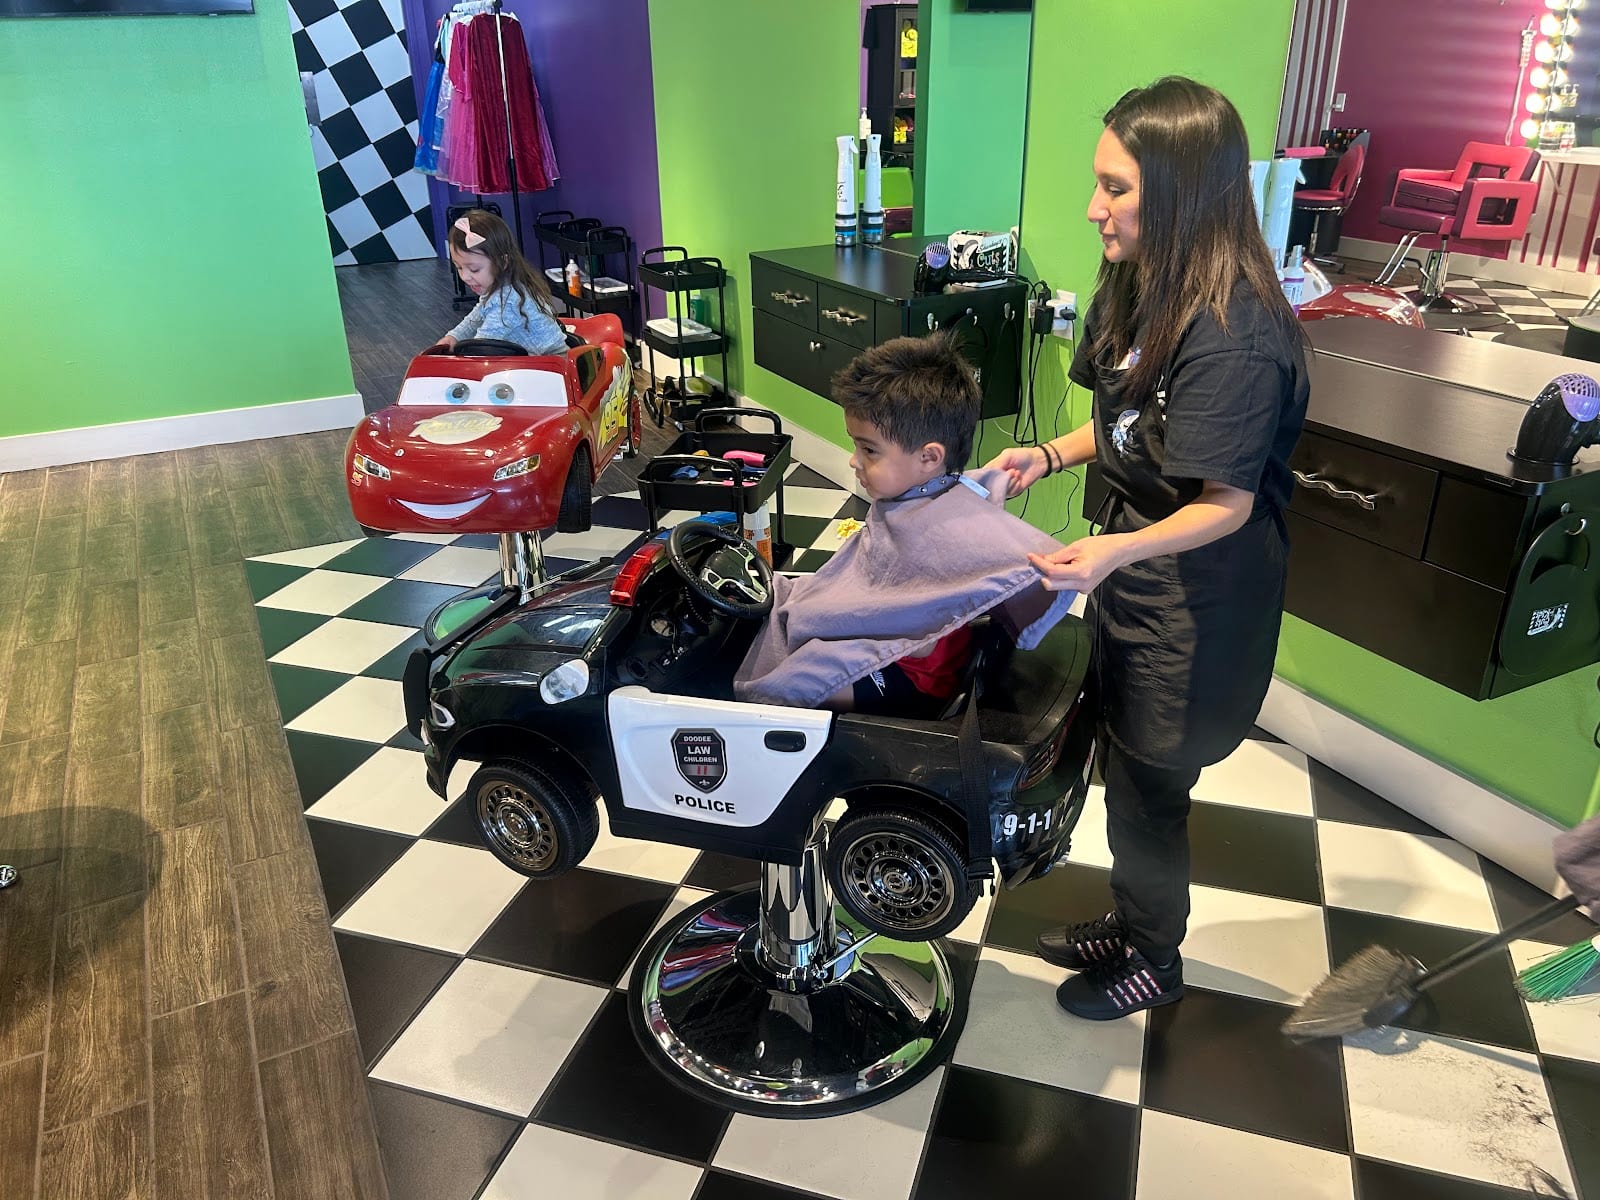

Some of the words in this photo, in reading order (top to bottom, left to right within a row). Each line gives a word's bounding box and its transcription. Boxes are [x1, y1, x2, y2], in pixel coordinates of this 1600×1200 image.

[977, 251, 1000, 267] Cuts
[687, 746, 711, 755] LAW
[674, 794, 736, 814] POLICE
[1003, 808, 1052, 836] 9-1-1
